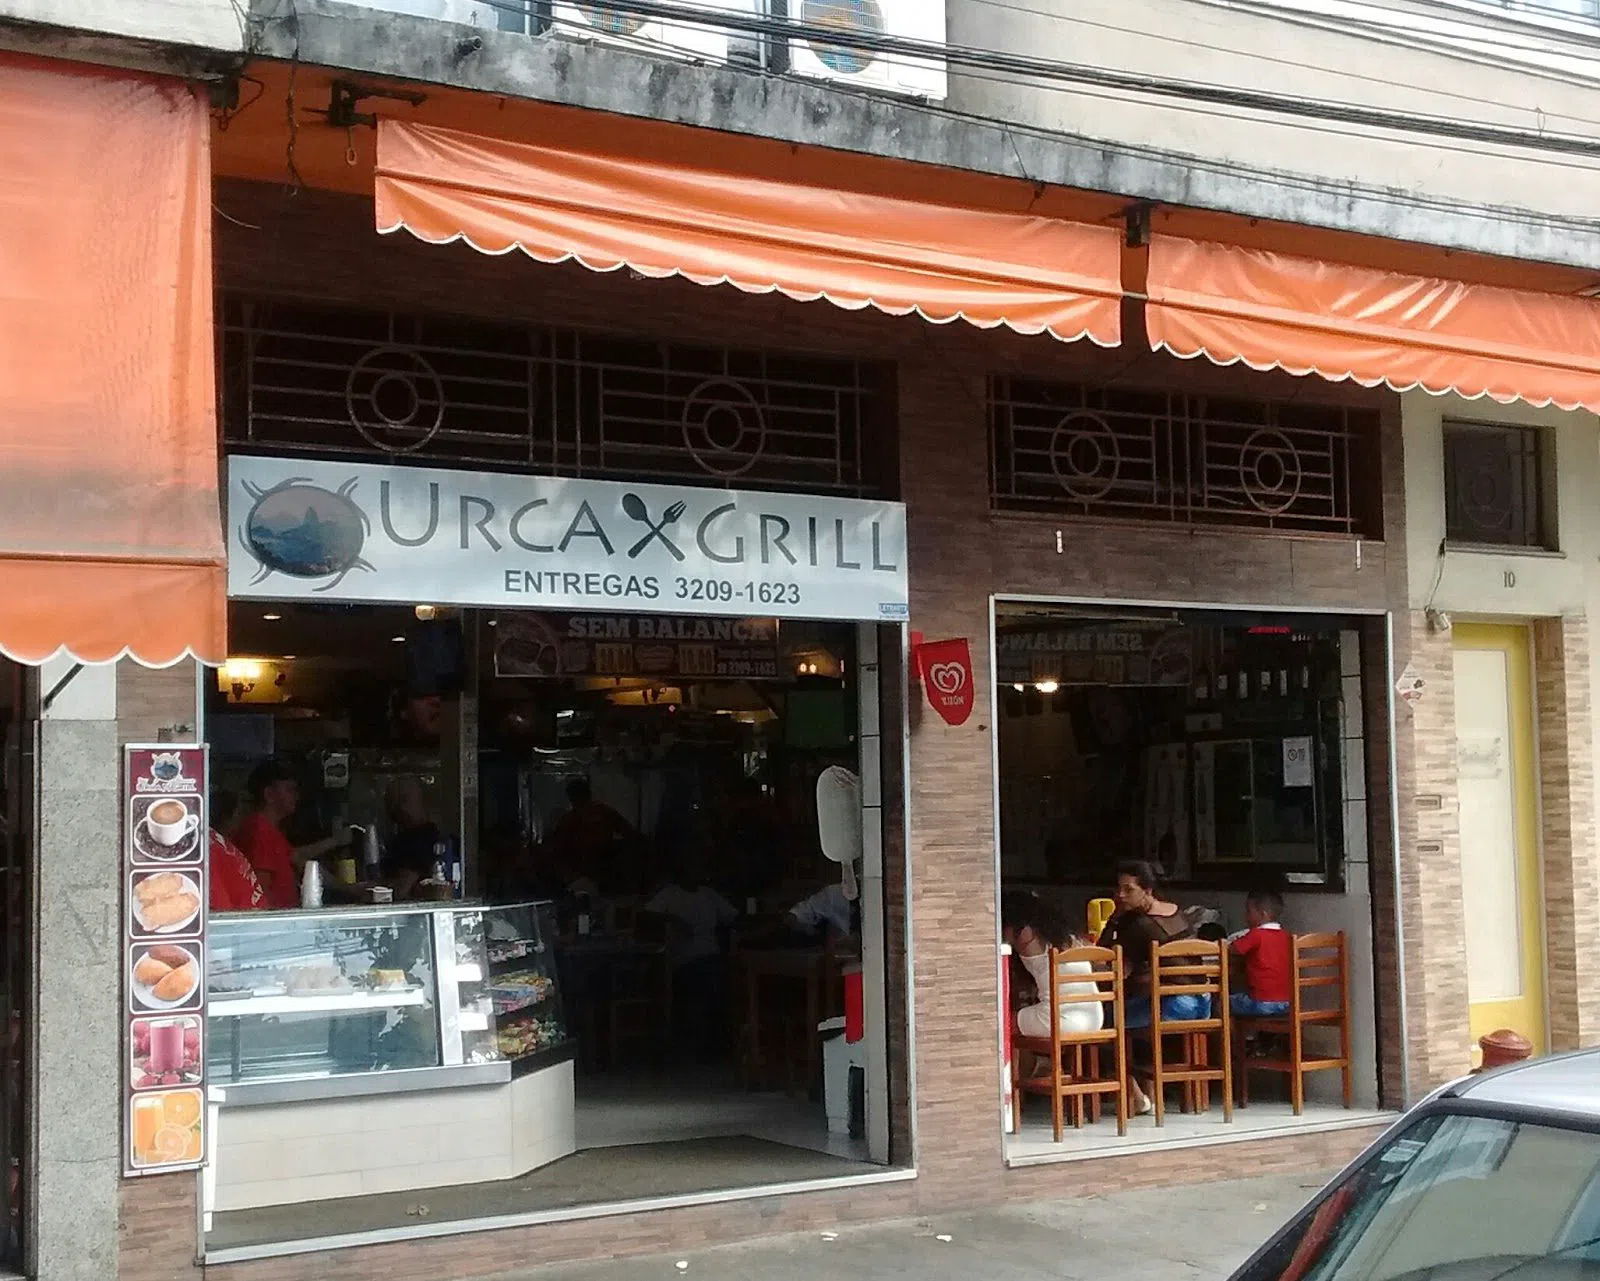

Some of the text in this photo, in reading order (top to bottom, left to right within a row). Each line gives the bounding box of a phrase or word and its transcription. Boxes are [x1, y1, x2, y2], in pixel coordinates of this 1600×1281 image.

[381, 480, 897, 572] URCA GRILL
[505, 569, 801, 605] ENTREGAS 3209-1623
[1504, 571, 1516, 588] 10
[568, 616, 771, 643] SEM BALANÇA
